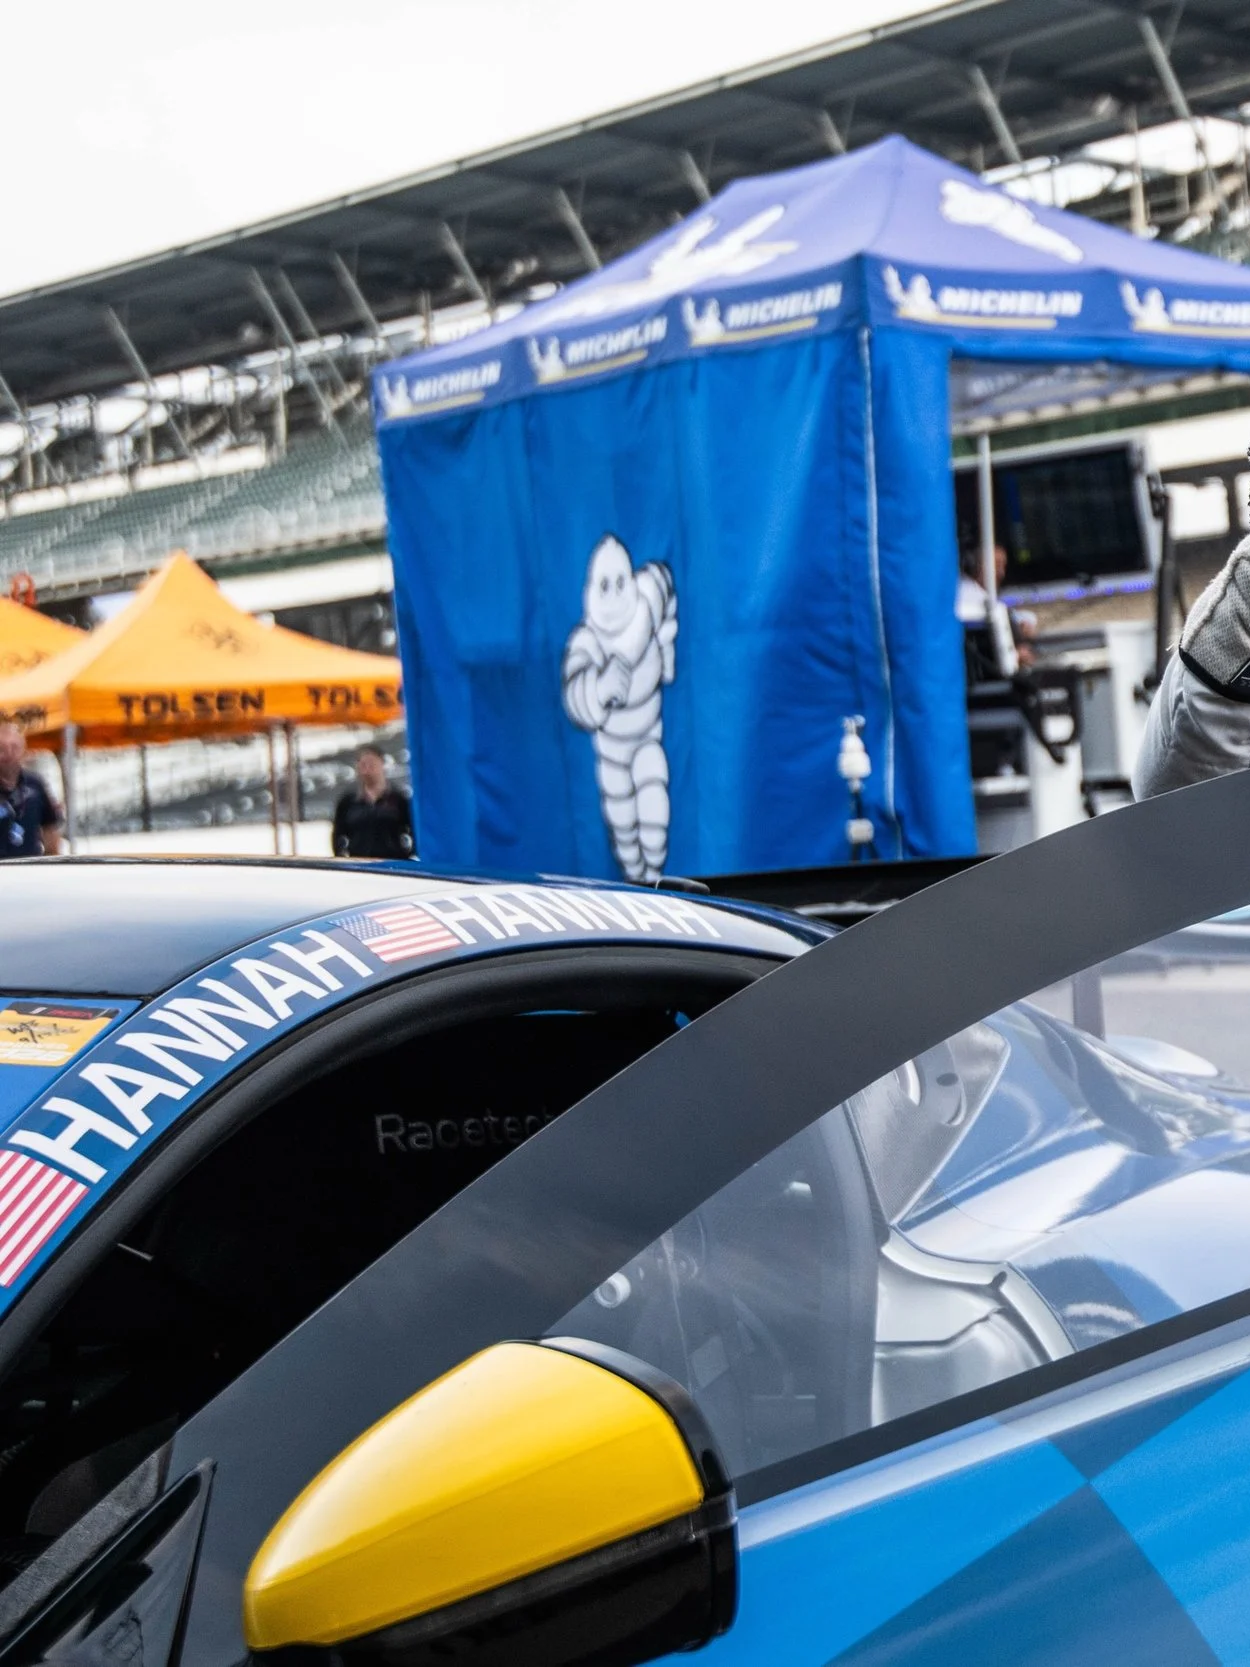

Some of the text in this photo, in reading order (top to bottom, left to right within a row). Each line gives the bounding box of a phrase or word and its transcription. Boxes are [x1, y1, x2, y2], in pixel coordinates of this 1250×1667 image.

[726, 283, 841, 328] MICHELIN
[938, 286, 1083, 317] MICHELIN
[567, 316, 667, 365] MICHELIN
[413, 362, 500, 400] MICHELIN
[118, 690, 264, 718] TOLSEN
[307, 685, 402, 708] TOLS
[416, 890, 722, 944] HANNAH
[9, 930, 371, 1183] HANNAH
